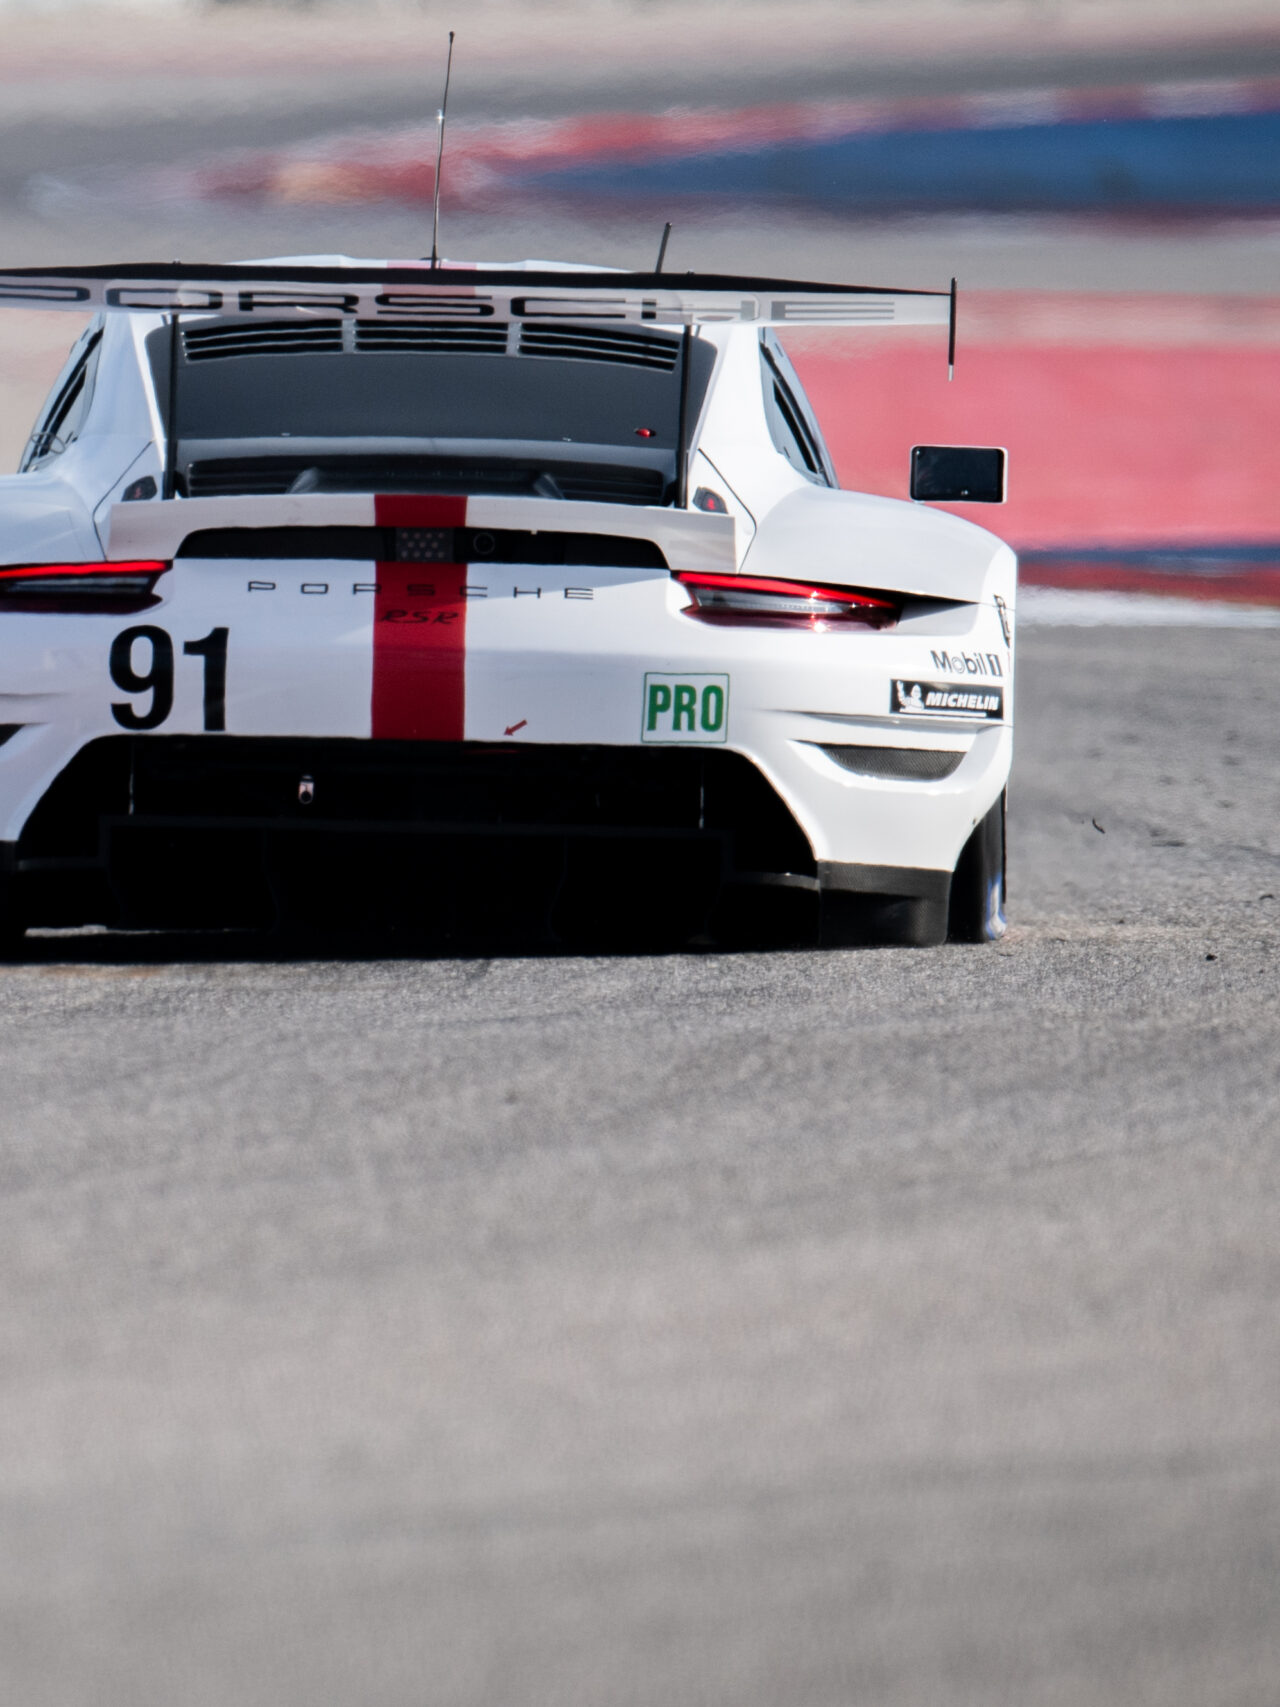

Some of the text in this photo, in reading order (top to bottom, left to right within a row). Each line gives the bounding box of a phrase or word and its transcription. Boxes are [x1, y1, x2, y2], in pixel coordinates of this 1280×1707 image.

[246, 580, 595, 600] PORSCHE
[380, 609, 459, 625] RSR
[930, 650, 988, 676] Mobil
[109, 625, 230, 731] 91
[647, 684, 725, 732] PRO
[925, 691, 1000, 711] MICHELIN
